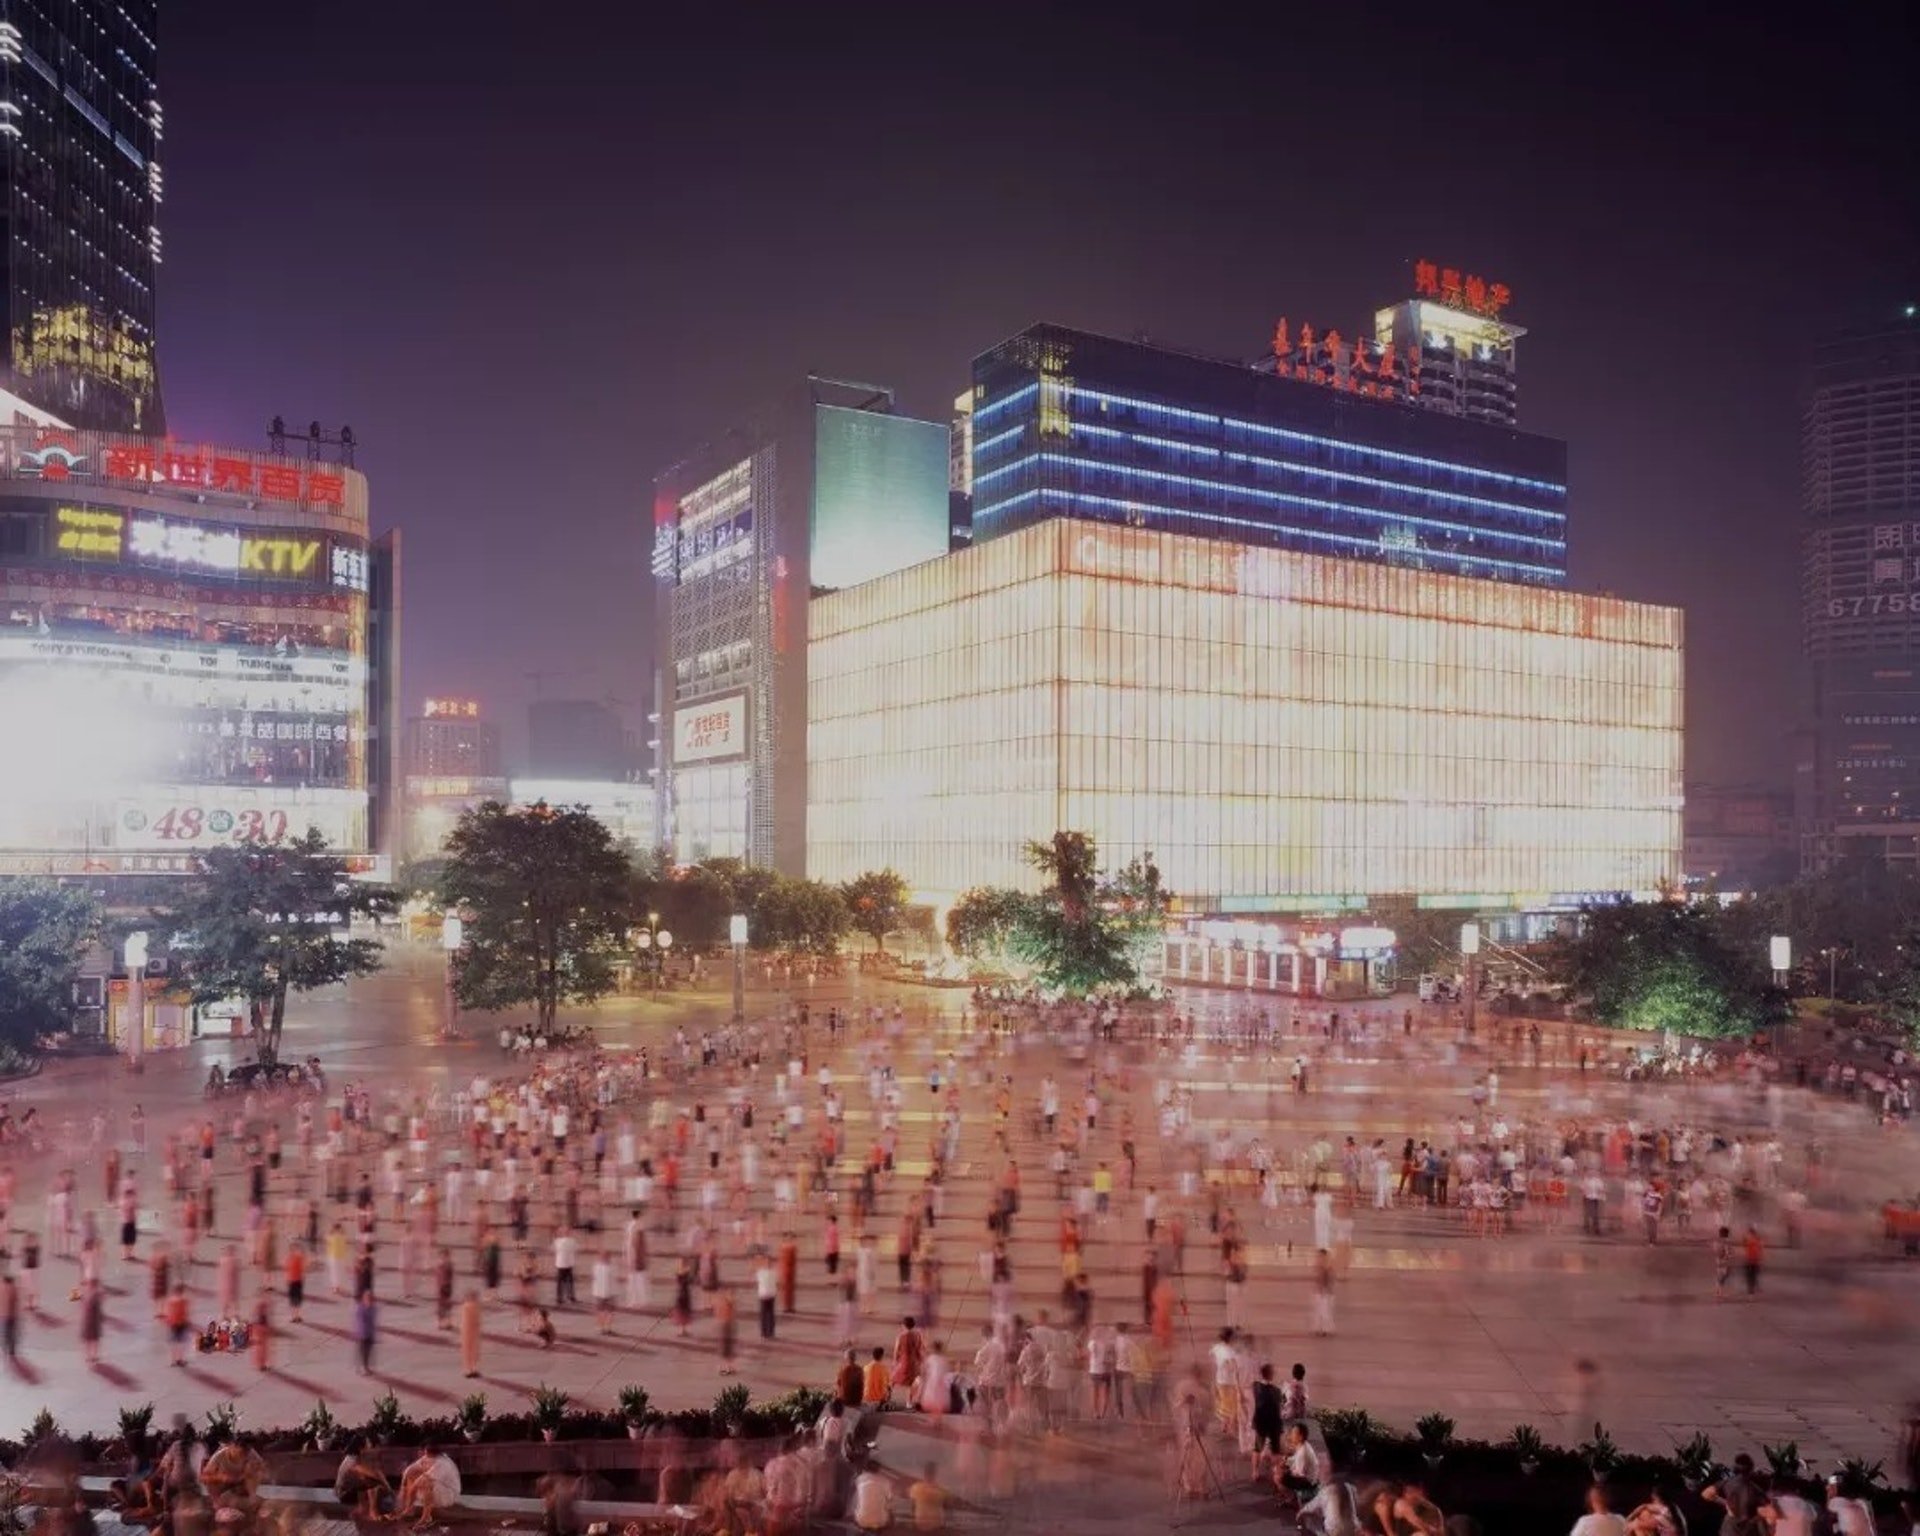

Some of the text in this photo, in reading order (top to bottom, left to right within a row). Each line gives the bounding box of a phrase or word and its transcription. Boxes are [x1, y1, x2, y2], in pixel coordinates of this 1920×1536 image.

[240, 540, 320, 572] KTV
[152, 807, 204, 840] 48
[232, 809, 288, 843] 30
